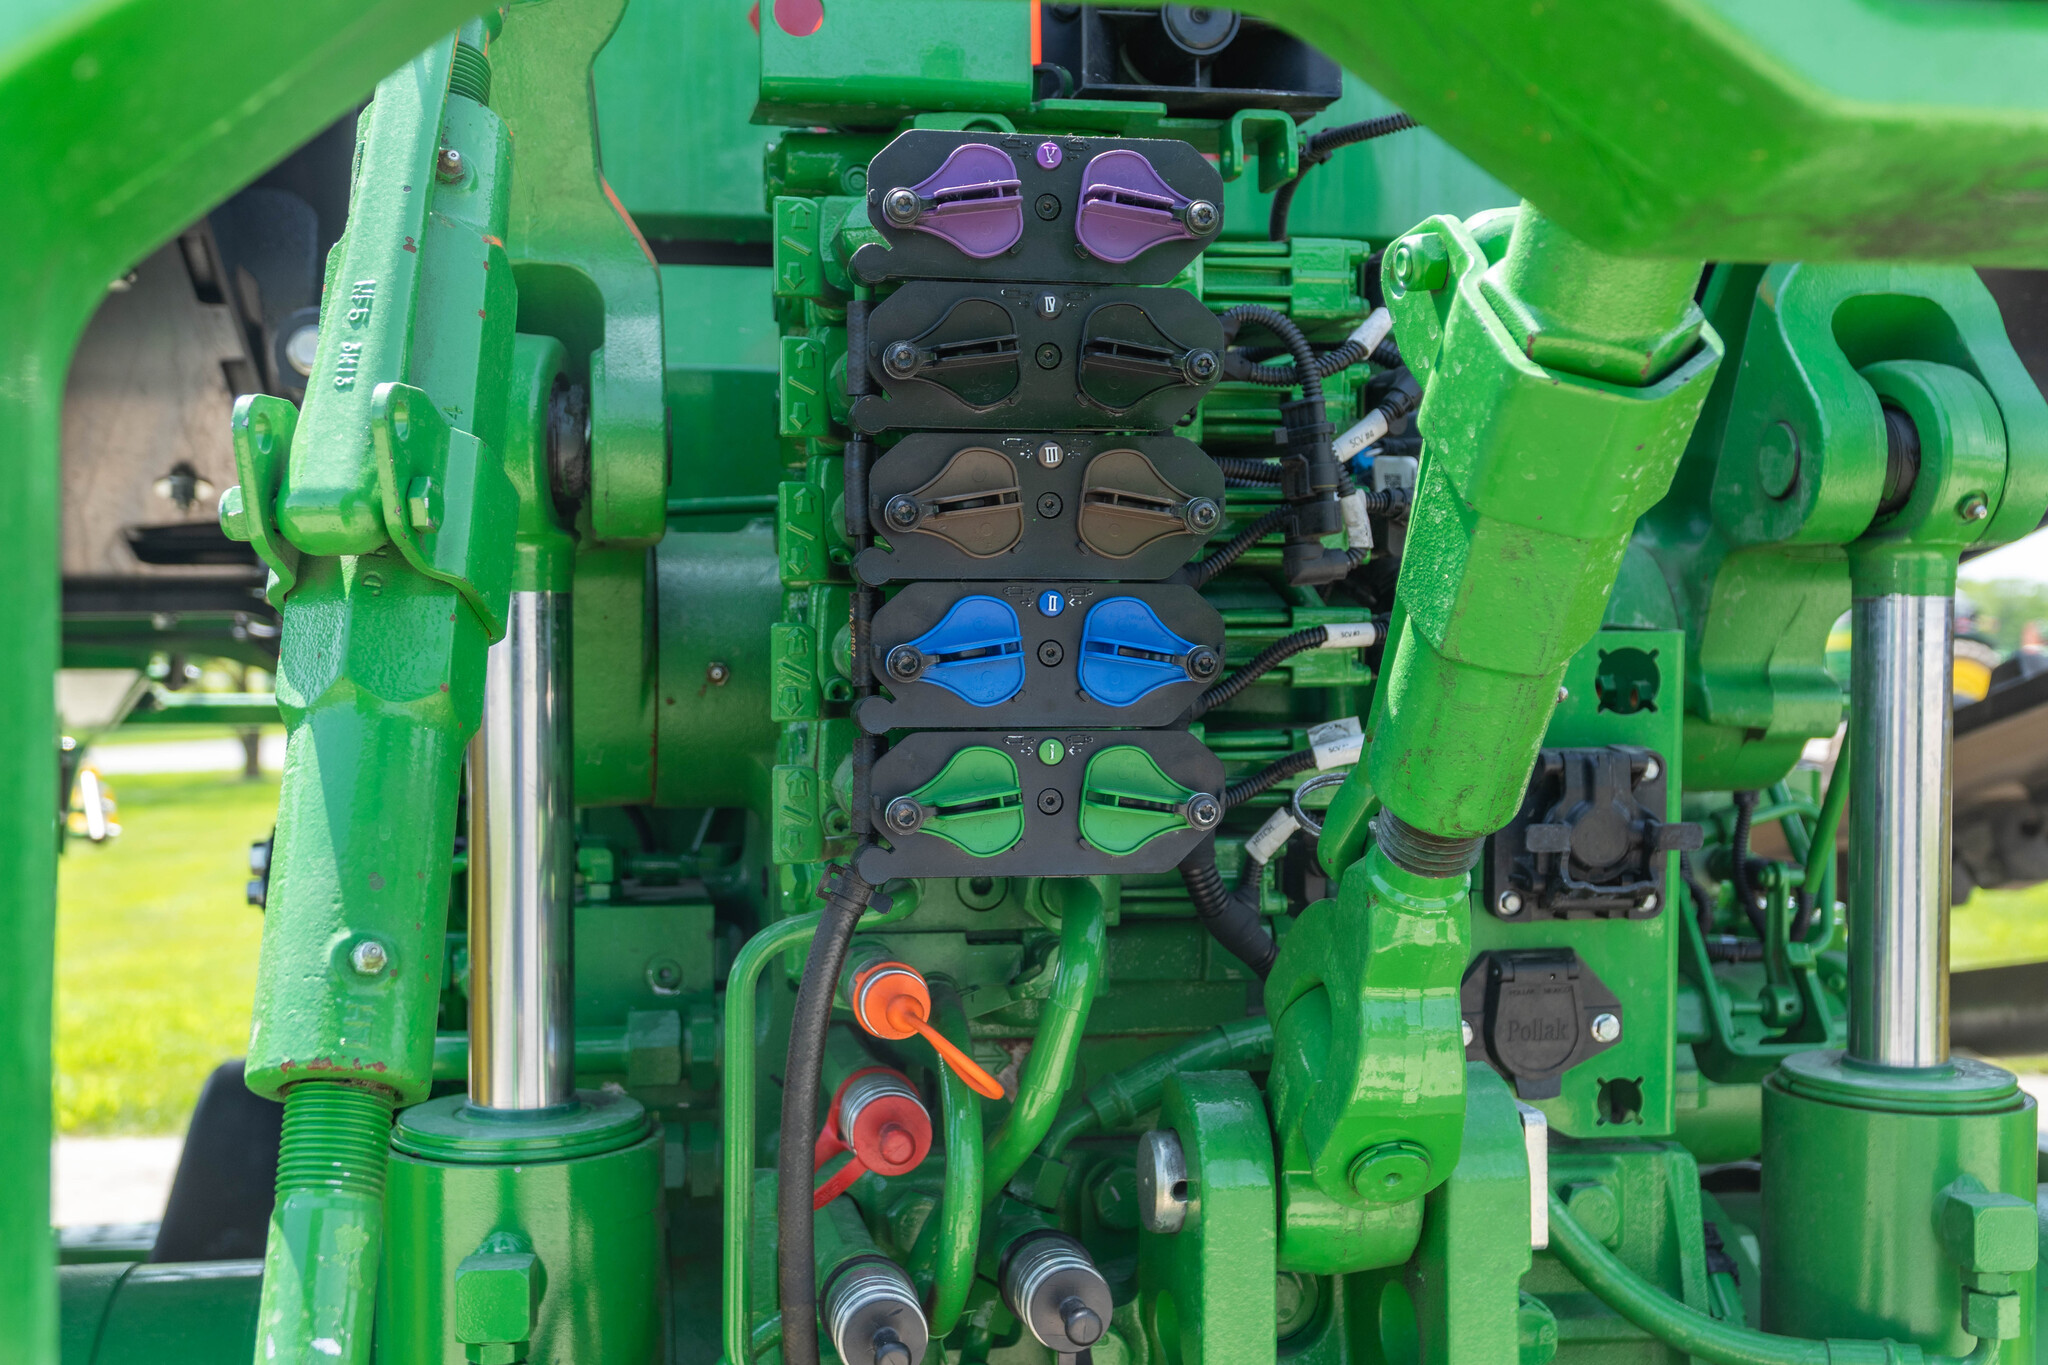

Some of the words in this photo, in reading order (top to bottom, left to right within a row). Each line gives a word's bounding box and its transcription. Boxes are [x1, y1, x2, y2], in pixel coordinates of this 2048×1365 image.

[1043, 145, 1058, 163] V
[1044, 296, 1056, 313] IV
[1349, 434, 1364, 448] SCV
[1044, 446, 1060, 463] III
[1047, 595, 1058, 612] II
[1341, 631, 1353, 639] SCV
[1252, 823, 1275, 847] HITCH
[1507, 1017, 1570, 1042] Pollak
